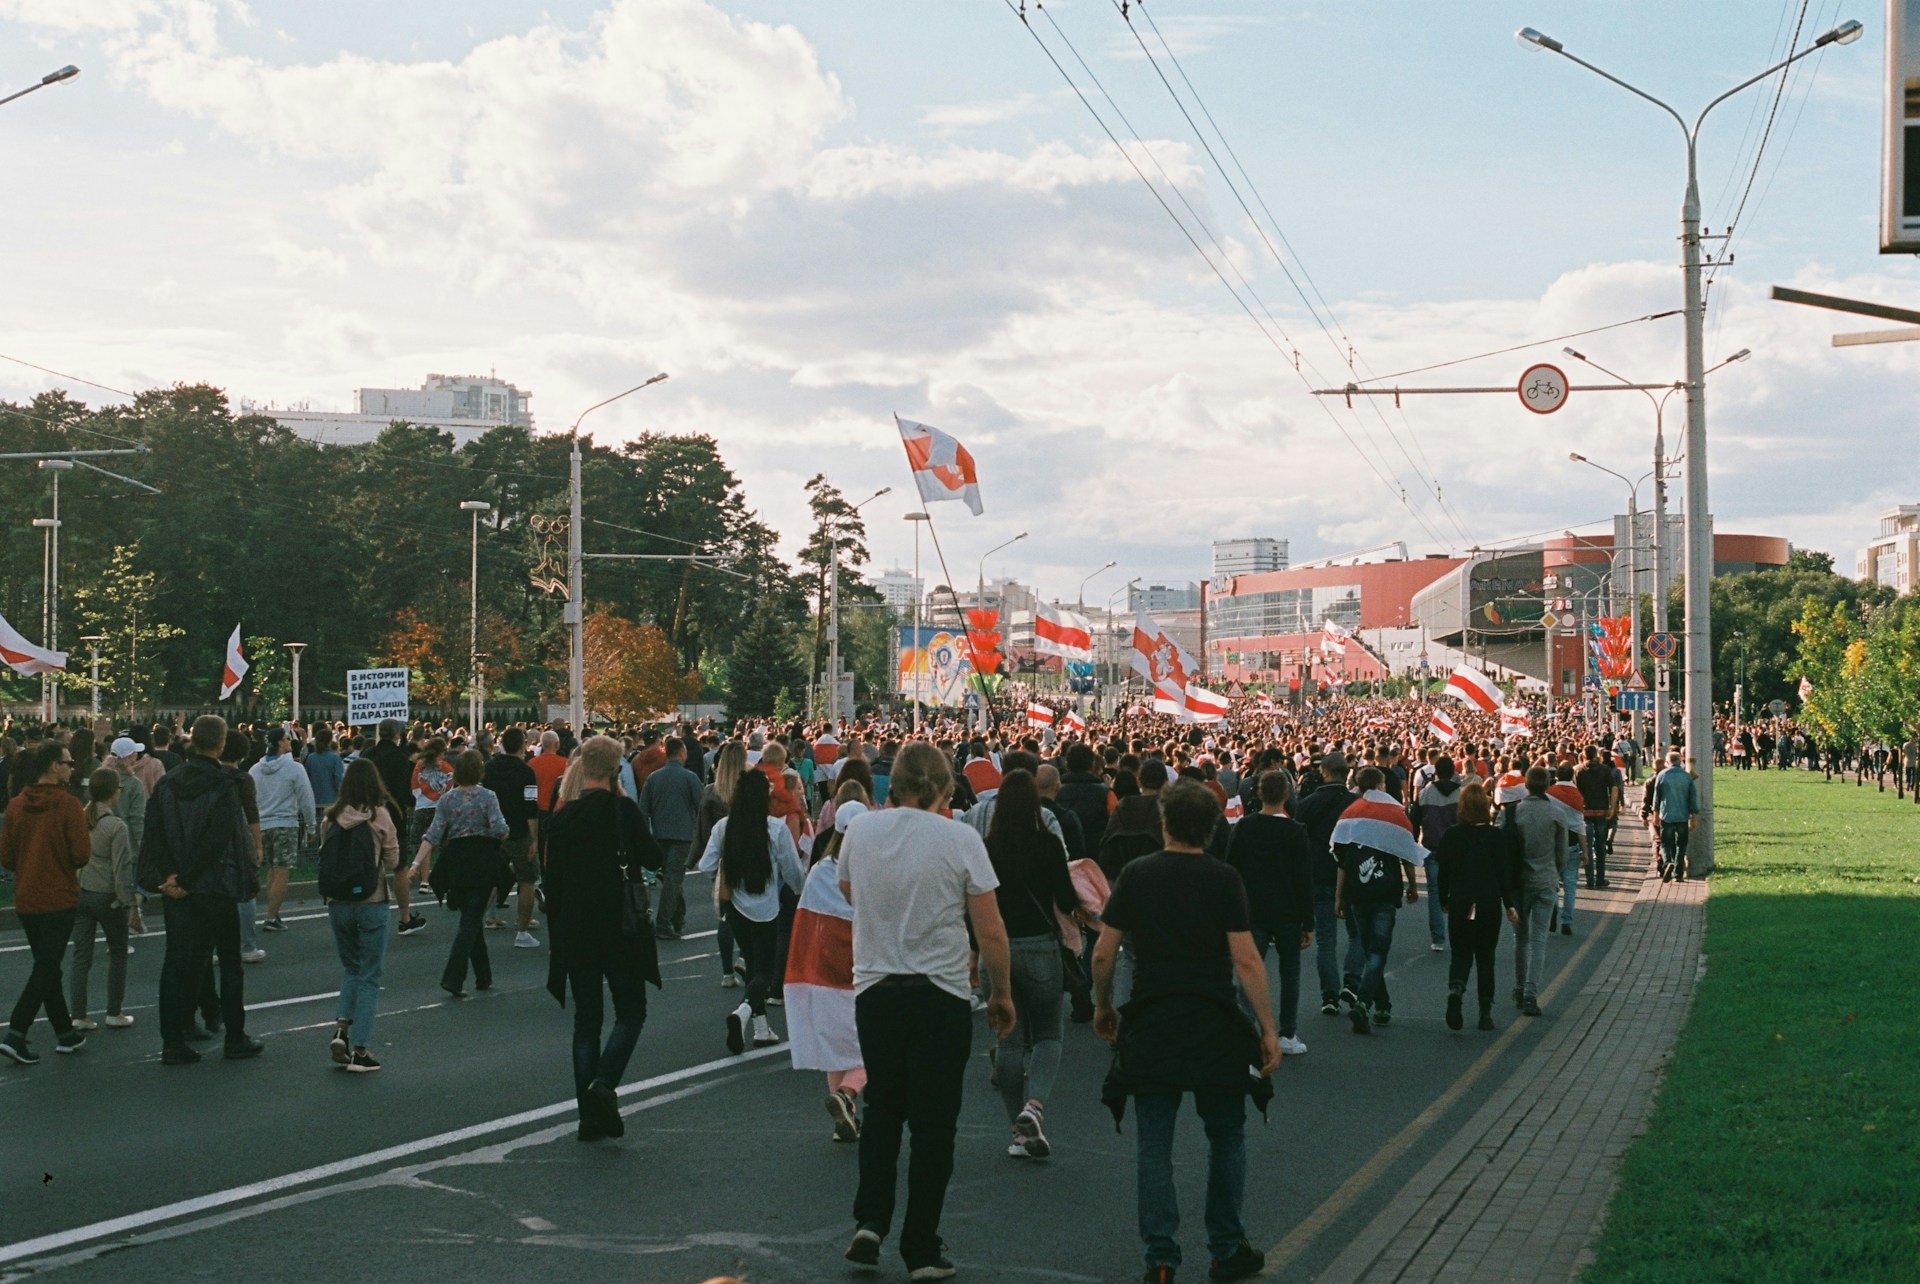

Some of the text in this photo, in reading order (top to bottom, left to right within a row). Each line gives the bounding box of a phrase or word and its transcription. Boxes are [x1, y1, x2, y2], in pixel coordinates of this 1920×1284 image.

[360, 671, 404, 681] ИСТОРИИ
[351, 680, 405, 691] БЕЛАРУСИ
[351, 692, 368, 701] ТЫ
[352, 700, 406, 711] ВСЕГО ЛИШЬ
[352, 709, 407, 720] ПАРАЗИТ!
[1359, 856, 1376, 875] NIKE
